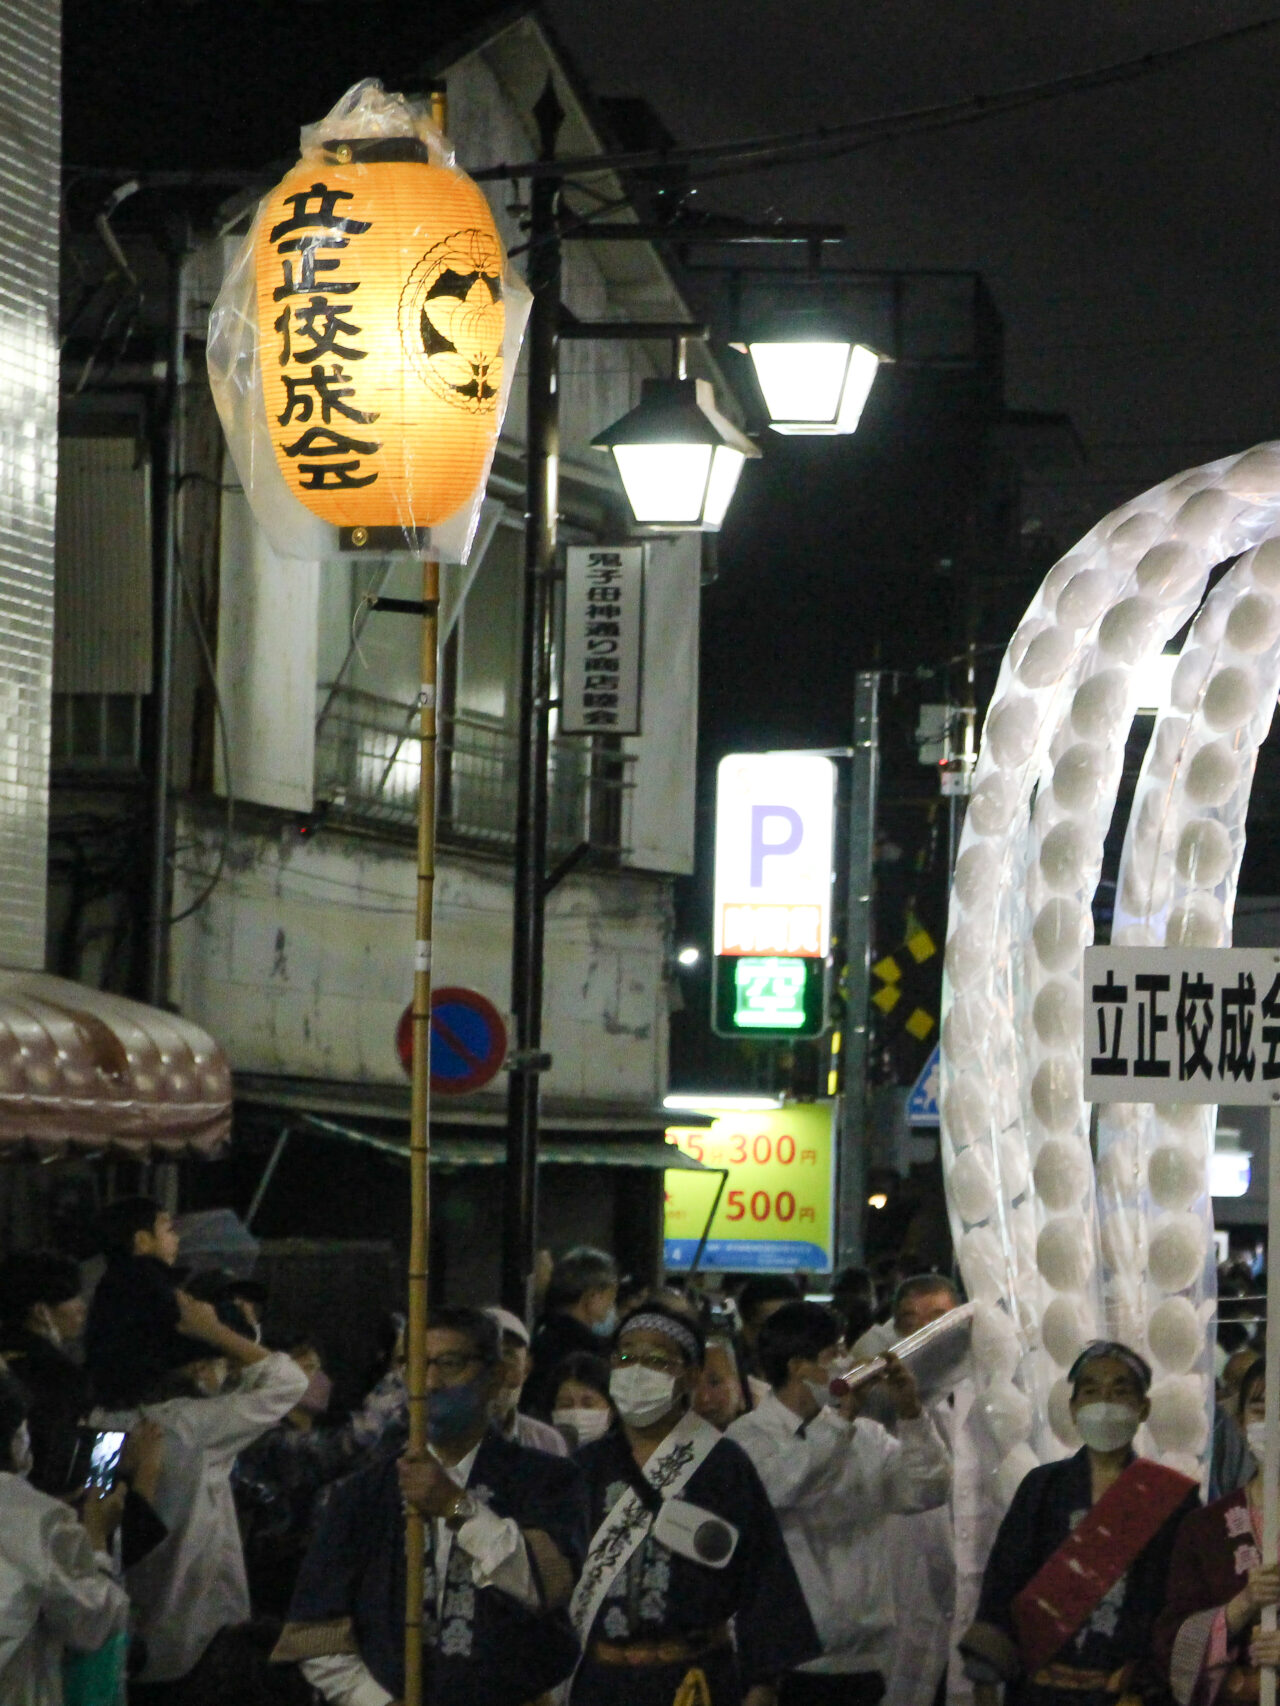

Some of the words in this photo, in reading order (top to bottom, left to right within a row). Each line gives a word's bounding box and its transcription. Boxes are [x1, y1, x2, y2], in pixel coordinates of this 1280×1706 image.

[270, 182, 383, 490] 立正佼成会
[749, 805, 804, 887] P
[735, 956, 806, 1028] 空
